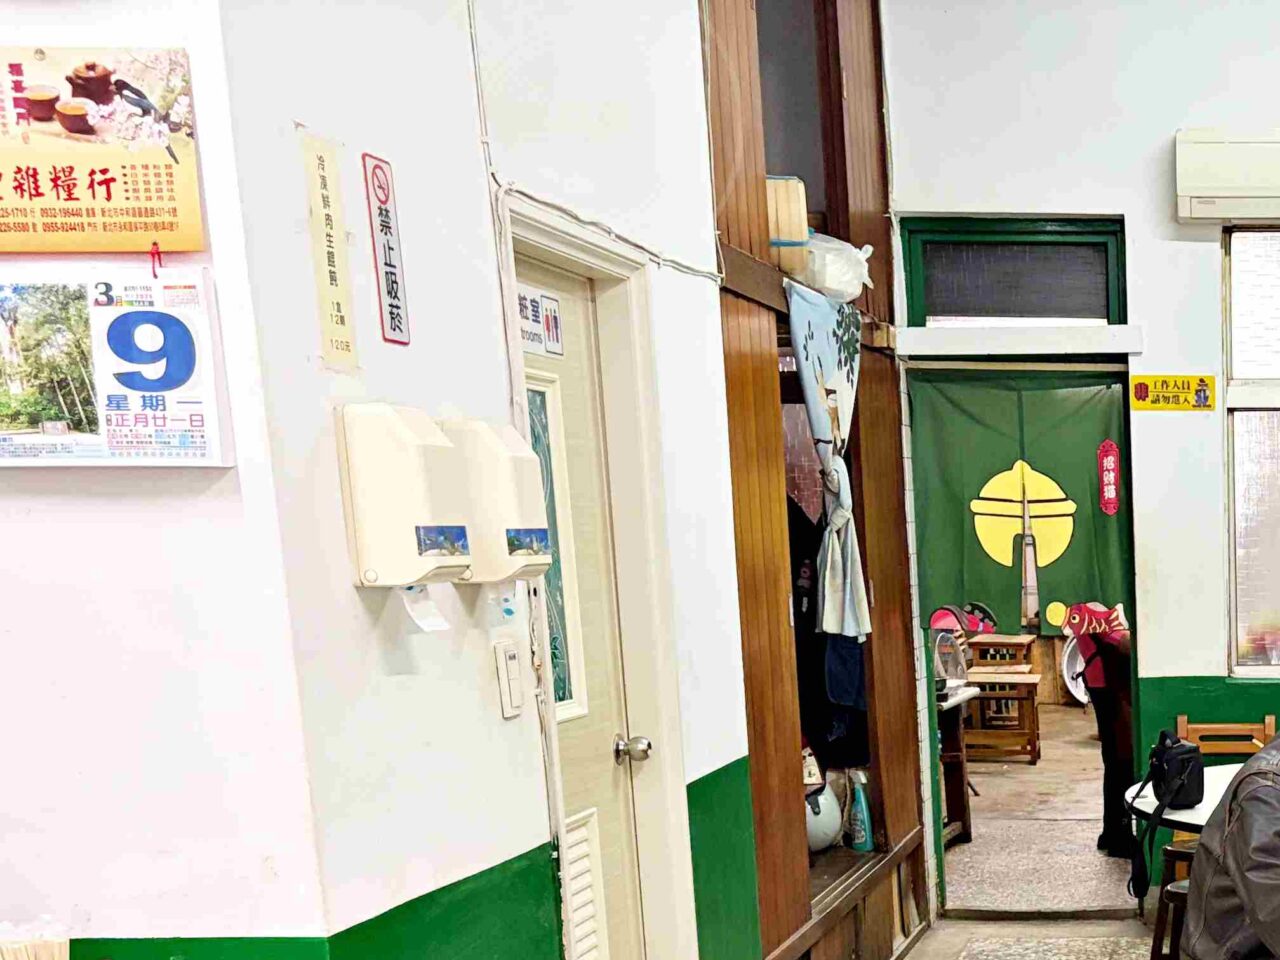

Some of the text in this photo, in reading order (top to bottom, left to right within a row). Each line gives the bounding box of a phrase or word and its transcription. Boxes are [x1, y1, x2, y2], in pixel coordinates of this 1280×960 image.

[0, 165, 116, 202] 雜糧行
[378, 206, 404, 333] 禁止吸菸
[107, 310, 197, 392] 9
[1152, 379, 1191, 391] 工作人員
[105, 394, 203, 411] 星期一
[1150, 394, 1191, 405] 請勿進入
